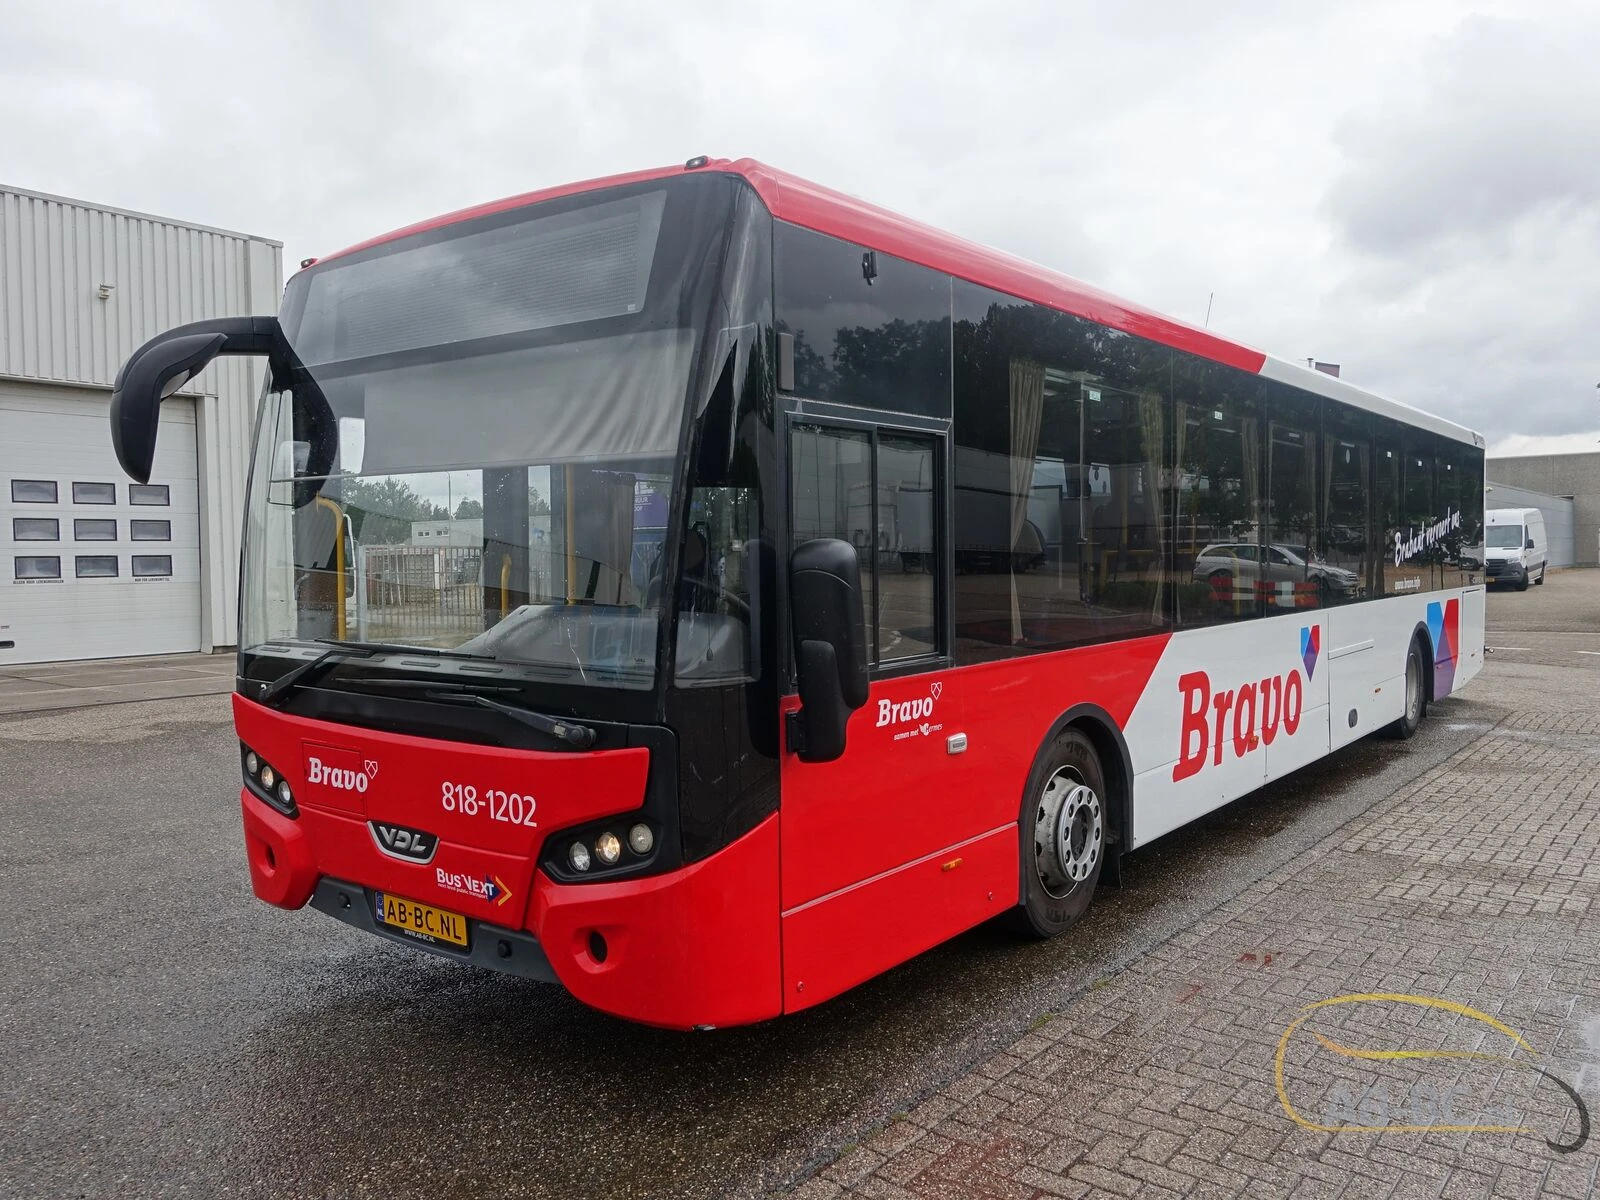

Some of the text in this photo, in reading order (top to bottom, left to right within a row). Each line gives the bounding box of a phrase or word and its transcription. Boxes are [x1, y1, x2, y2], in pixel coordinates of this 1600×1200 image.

[1394, 521, 1425, 568] Brabant
[876, 697, 933, 727] Bravo
[1172, 668, 1302, 783] Bravo
[910, 728, 919, 737] met
[308, 757, 368, 793] Bravo
[442, 781, 537, 828] 818-1202
[379, 826, 427, 853] VDL
[387, 899, 462, 941] AB-BC.NL
